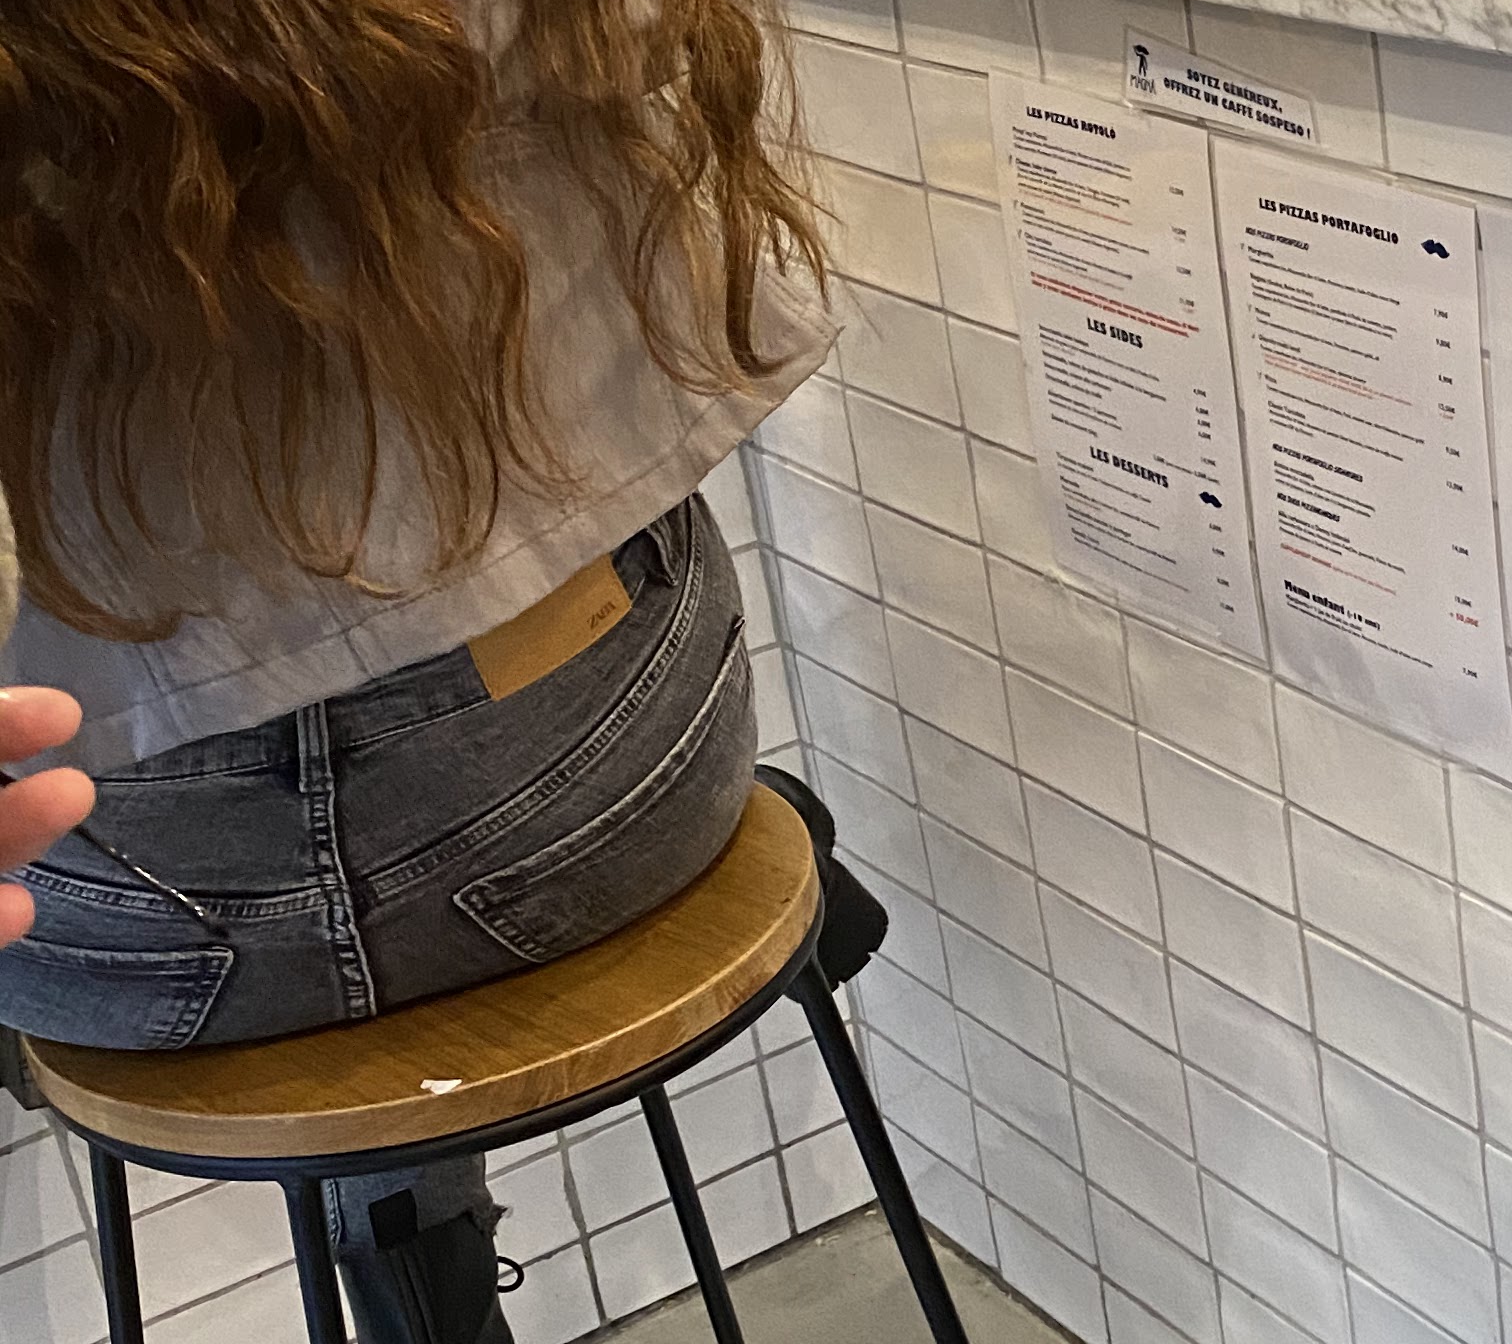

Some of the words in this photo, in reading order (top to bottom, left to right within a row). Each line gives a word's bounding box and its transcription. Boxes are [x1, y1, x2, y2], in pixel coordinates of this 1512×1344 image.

[1187, 68, 1220, 90] SOYEZ
[1026, 105, 1043, 120] LES
[1044, 110, 1079, 130] PIZZAS
[1163, 77, 1201, 101] OFFREZ
[1203, 91, 1219, 107] UN
[1255, 110, 1304, 138] SOSPESO
[1258, 197, 1277, 213] LES
[1279, 202, 1319, 223] PIZZAS
[1321, 214, 1399, 245] PORTAFOGLIO
[1086, 316, 1107, 335] LES
[1109, 325, 1144, 349] SIDES
[1089, 445, 1110, 464] LES
[1112, 455, 1169, 488] DESSERTS
[1284, 579, 1311, 600] Menu
[1312, 594, 1345, 615] enfant
